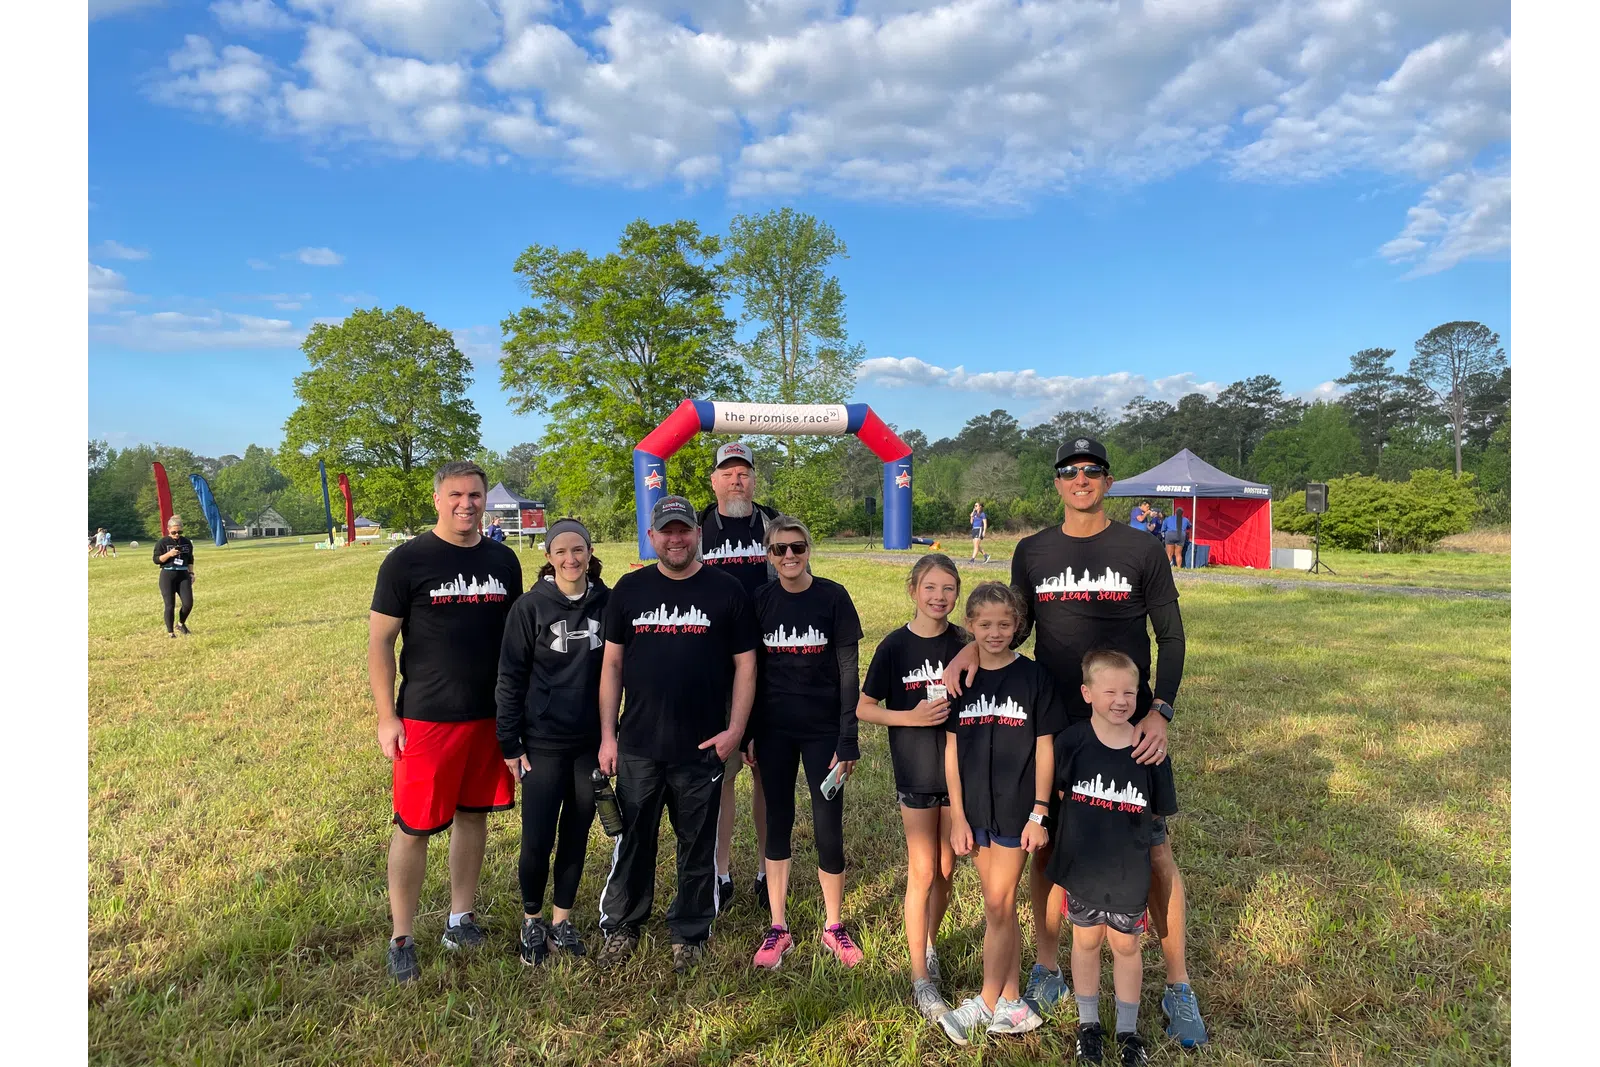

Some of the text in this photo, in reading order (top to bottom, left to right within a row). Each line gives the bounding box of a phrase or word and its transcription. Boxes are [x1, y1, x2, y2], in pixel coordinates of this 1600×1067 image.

[724, 411, 830, 425] the promise race
[1243, 487, 1263, 495] BOOSTER
